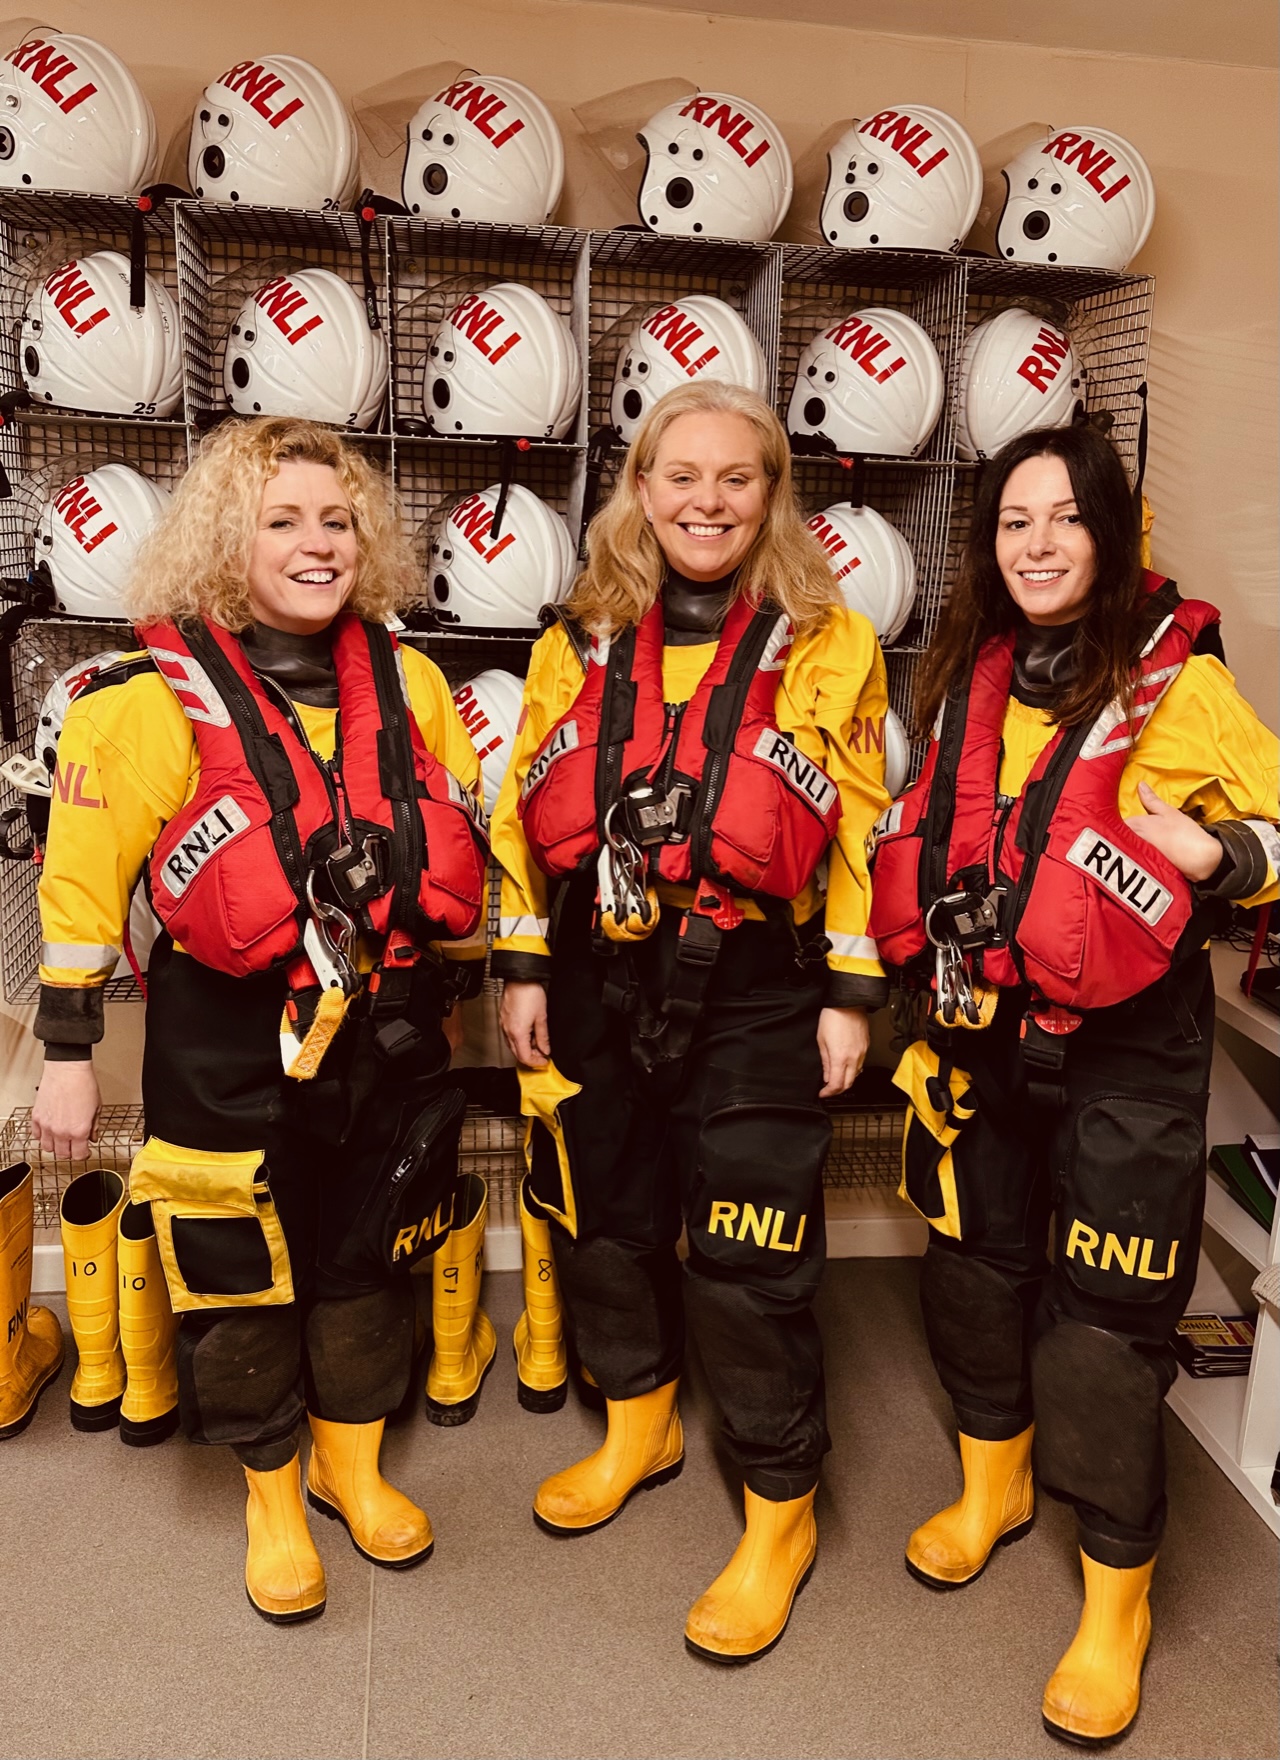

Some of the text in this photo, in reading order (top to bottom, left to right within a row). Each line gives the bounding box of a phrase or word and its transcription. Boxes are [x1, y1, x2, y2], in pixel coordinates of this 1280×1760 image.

[6, 40, 97, 114] RNLI
[219, 60, 304, 129] RNLI
[435, 80, 525, 149] RNLI
[680, 97, 771, 168] RNLI
[859, 111, 949, 178] RNLI
[1042, 132, 1131, 203] RNLI
[45, 260, 110, 338] RNLI
[252, 275, 324, 346] RNLI
[447, 294, 521, 366] RNLI
[643, 305, 720, 377] RNLI
[825, 316, 906, 384] RNLI
[1016, 318, 1070, 394] RNL
[132, 402, 157, 415] 25
[346, 412, 358, 426] 2
[544, 424, 555, 438] 3
[54, 476, 119, 554] RNLI
[448, 494, 516, 564] RNLI
[52, 758, 109, 809] NL
[527, 728, 567, 788] RNLI
[768, 738, 829, 805] RNLI
[167, 808, 235, 884] RNLI
[1083, 840, 1161, 914] RNLI
[393, 1192, 456, 1262] RNLI
[708, 1201, 807, 1252] RNLI
[1066, 1219, 1179, 1280] RNLI
[73, 1261, 97, 1277] 10
[123, 1275, 146, 1291] 10
[443, 1267, 459, 1285] 9
[538, 1258, 552, 1282] 8
[1184, 1322, 1223, 1330] THINK
